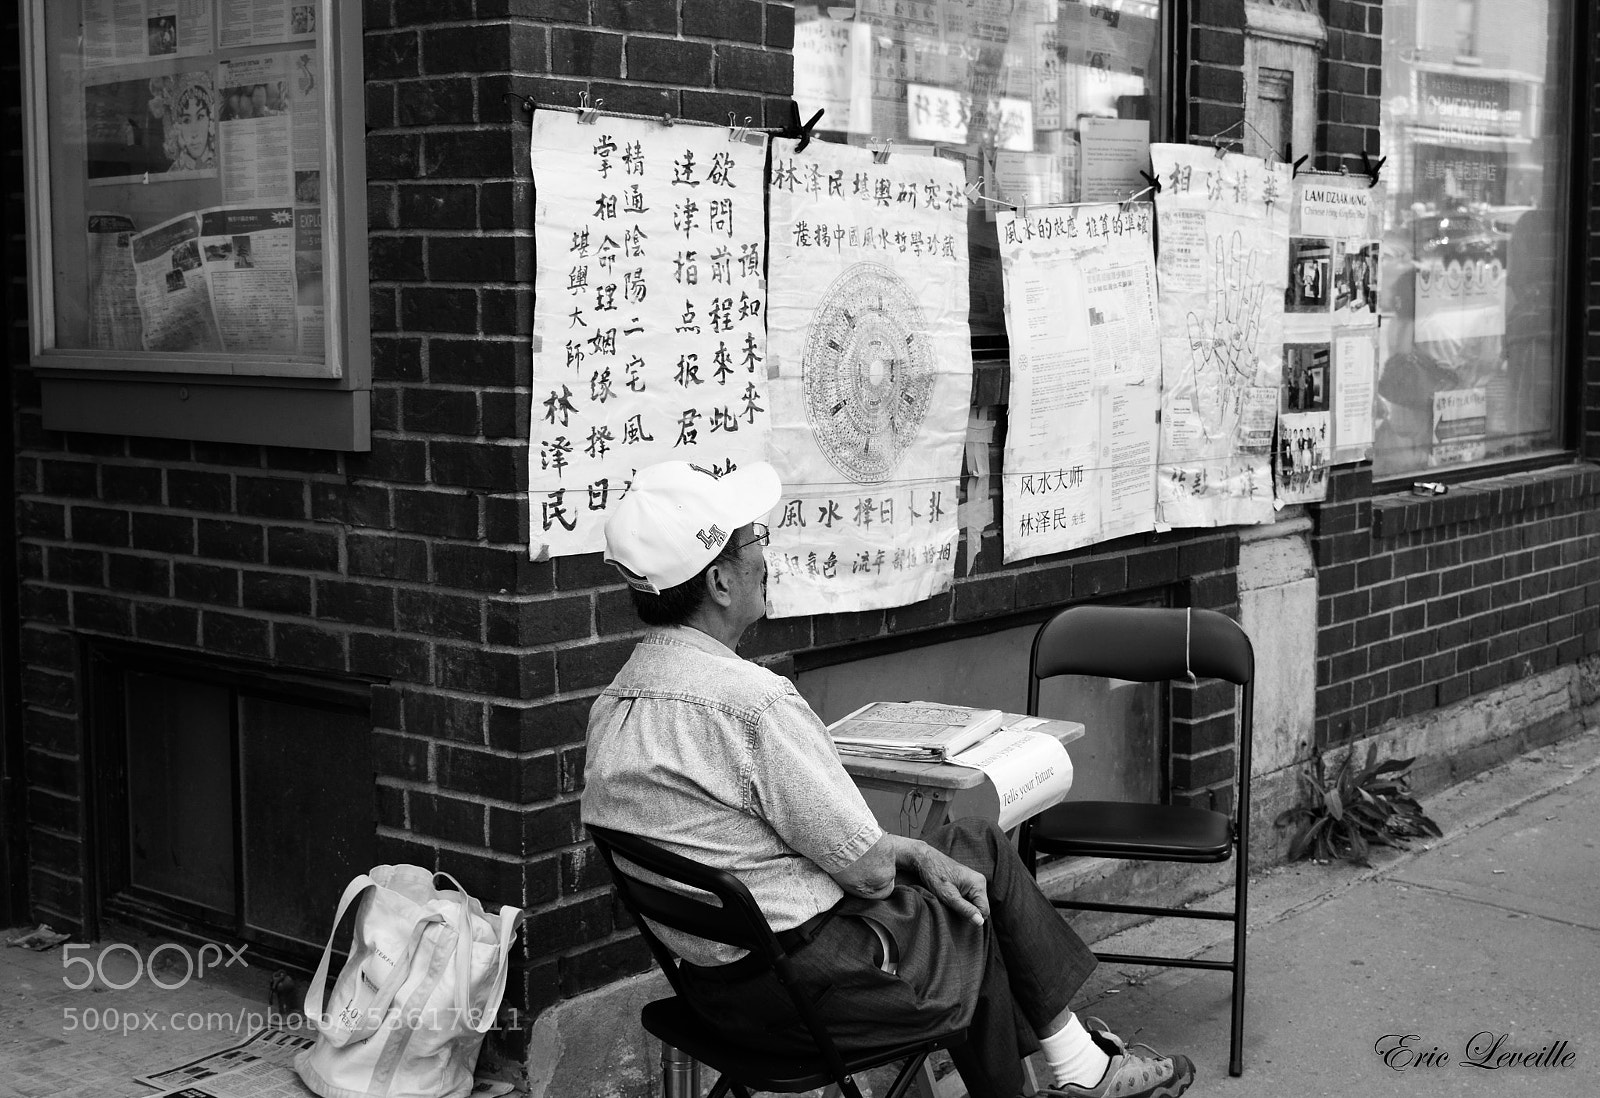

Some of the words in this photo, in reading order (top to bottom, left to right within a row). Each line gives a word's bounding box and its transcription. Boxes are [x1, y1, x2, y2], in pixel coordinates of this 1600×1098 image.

[1304, 189, 1324, 202] LAM
[1020, 464, 1084, 498] 风水大师
[696, 523, 728, 550] LA
[1019, 507, 1067, 537] 林泽民
[1002, 788, 1019, 807] Tells
[1019, 779, 1034, 800] your
[1034, 766, 1055, 786] future
